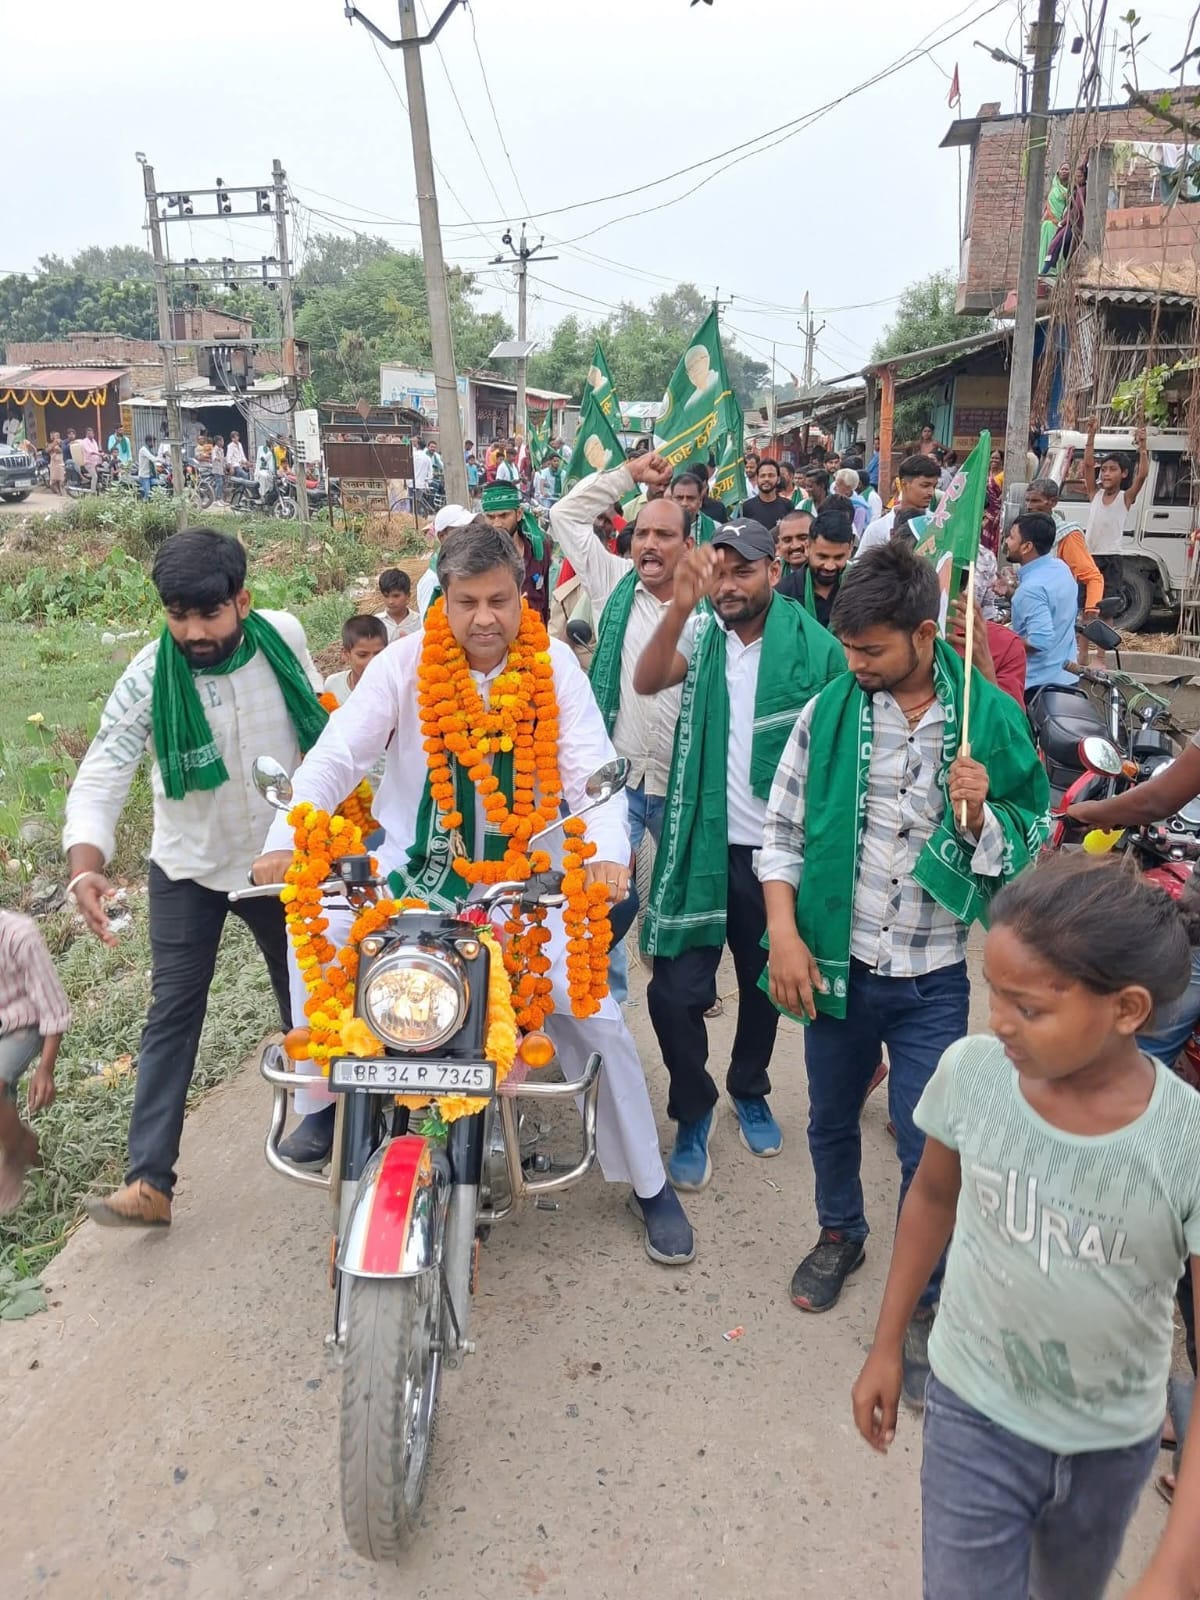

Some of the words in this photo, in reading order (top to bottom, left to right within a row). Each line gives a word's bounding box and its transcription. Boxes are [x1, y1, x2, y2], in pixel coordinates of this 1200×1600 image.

[354, 1064, 378, 1082] BR
[385, 1066, 409, 1083] 34
[417, 1067, 428, 1082] R
[437, 1065, 484, 1086] 7345
[971, 1164, 1138, 1274] RURAL
